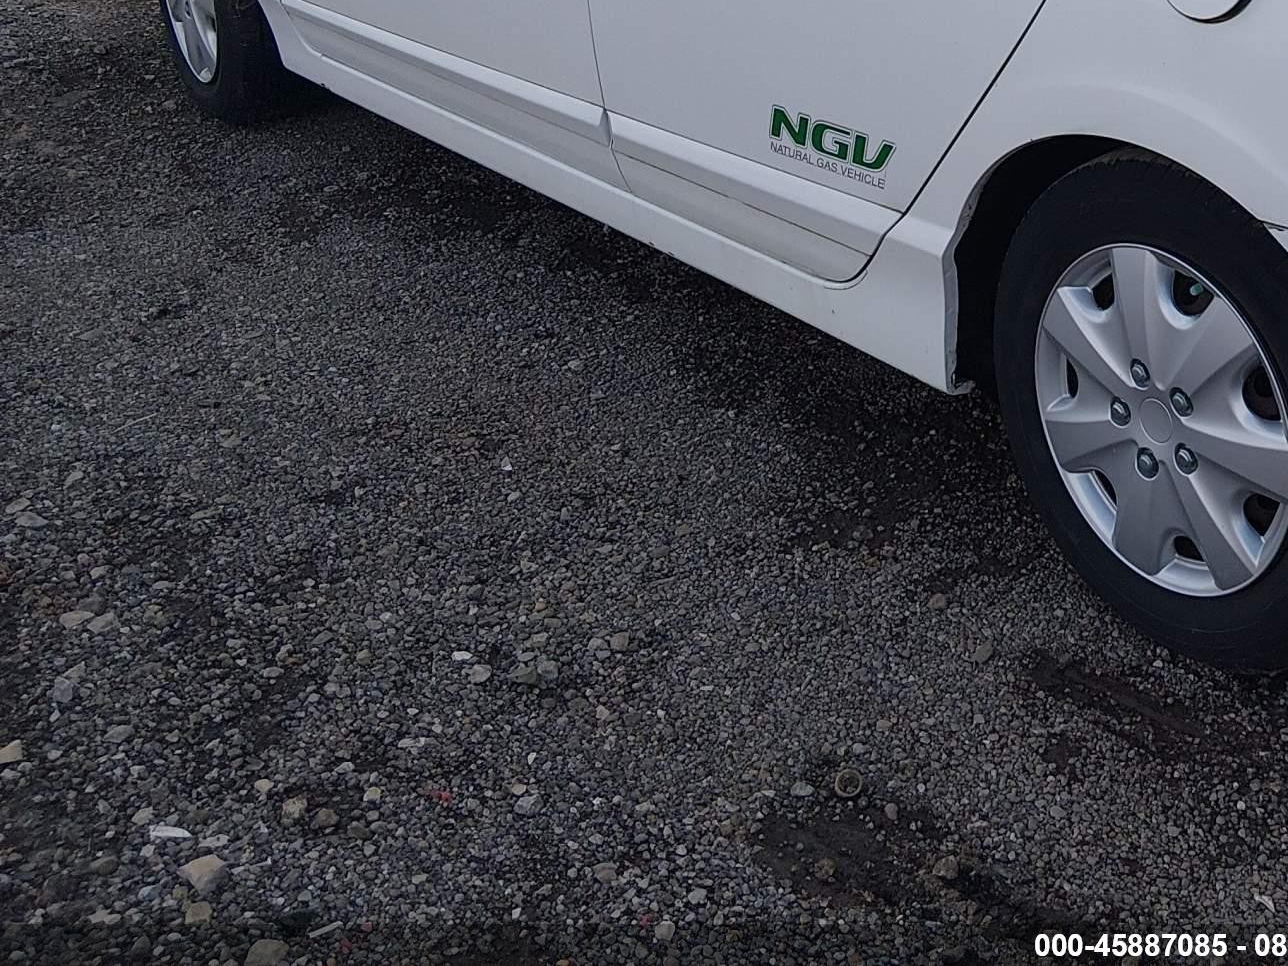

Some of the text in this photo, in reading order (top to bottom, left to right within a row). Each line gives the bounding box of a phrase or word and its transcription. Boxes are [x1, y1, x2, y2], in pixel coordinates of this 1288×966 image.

[770, 106, 897, 171] NGV
[770, 141, 886, 189] NATURAL GAS VEHICLE
